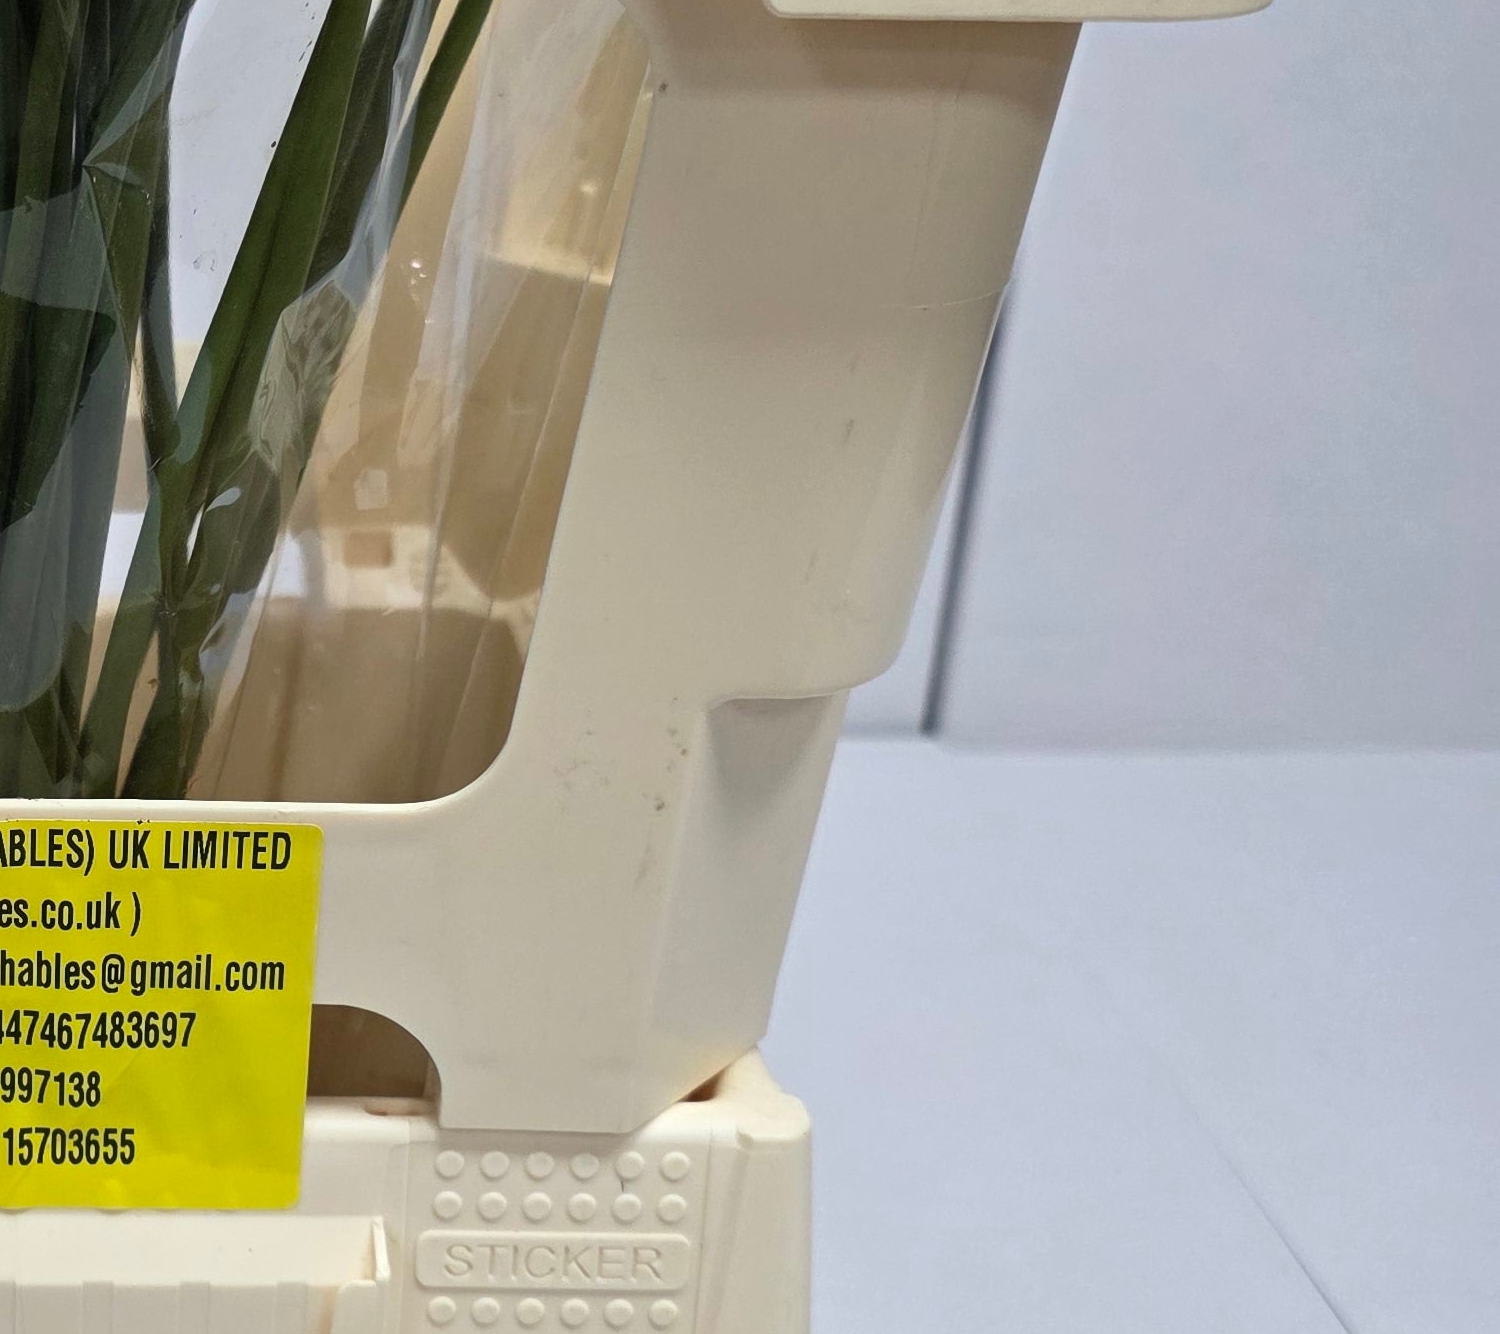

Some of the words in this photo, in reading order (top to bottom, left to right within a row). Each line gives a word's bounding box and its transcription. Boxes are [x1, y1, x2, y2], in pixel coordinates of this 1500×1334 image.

[109, 829, 151, 870] UK
[163, 830, 292, 870] LIMITED
[2, 1126, 136, 1167] 15703655
[444, 1244, 663, 1282] STICKER
